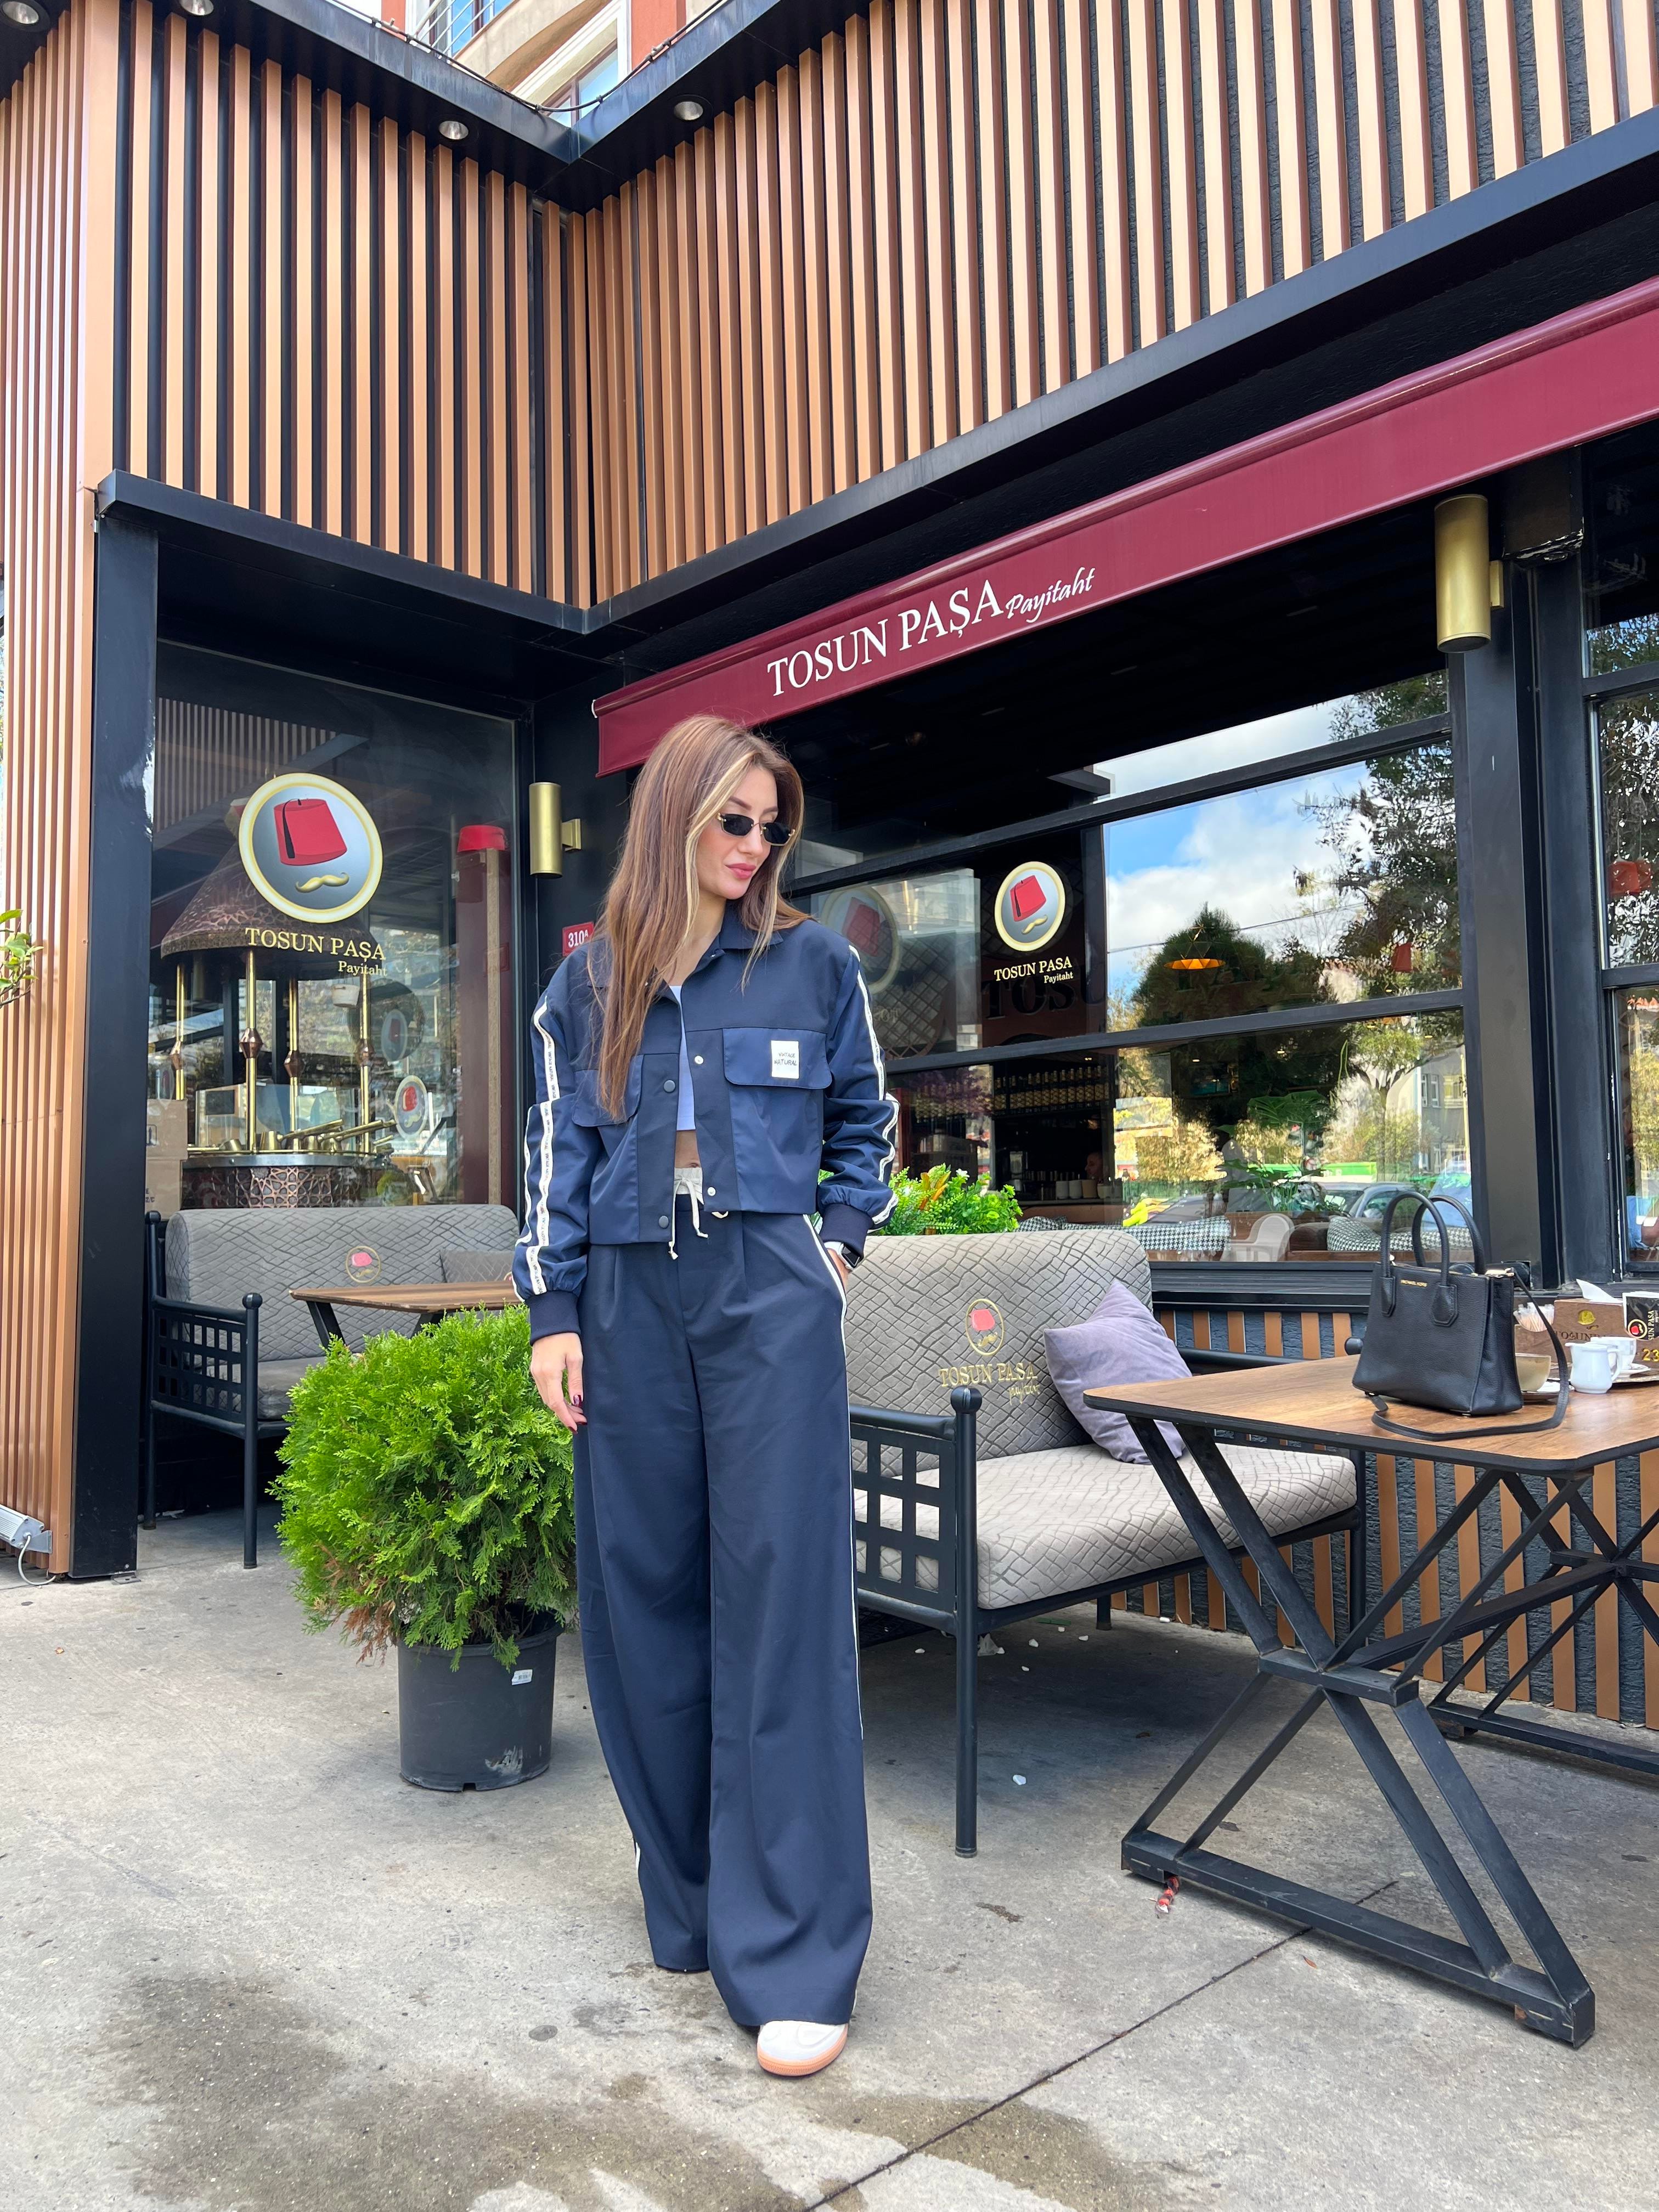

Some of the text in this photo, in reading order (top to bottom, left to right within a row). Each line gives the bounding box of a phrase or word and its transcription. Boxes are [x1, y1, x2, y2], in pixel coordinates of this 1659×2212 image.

[767, 567, 1096, 696] TOSUN PAŞA Payitaht
[245, 928, 386, 962] TOSUN PAŞA
[338, 960, 387, 976] Payitaht
[994, 956, 1073, 981] TOSUN PASA
[1043, 971, 1074, 984] Payitaht
[939, 1364, 993, 1387] TOSUN
